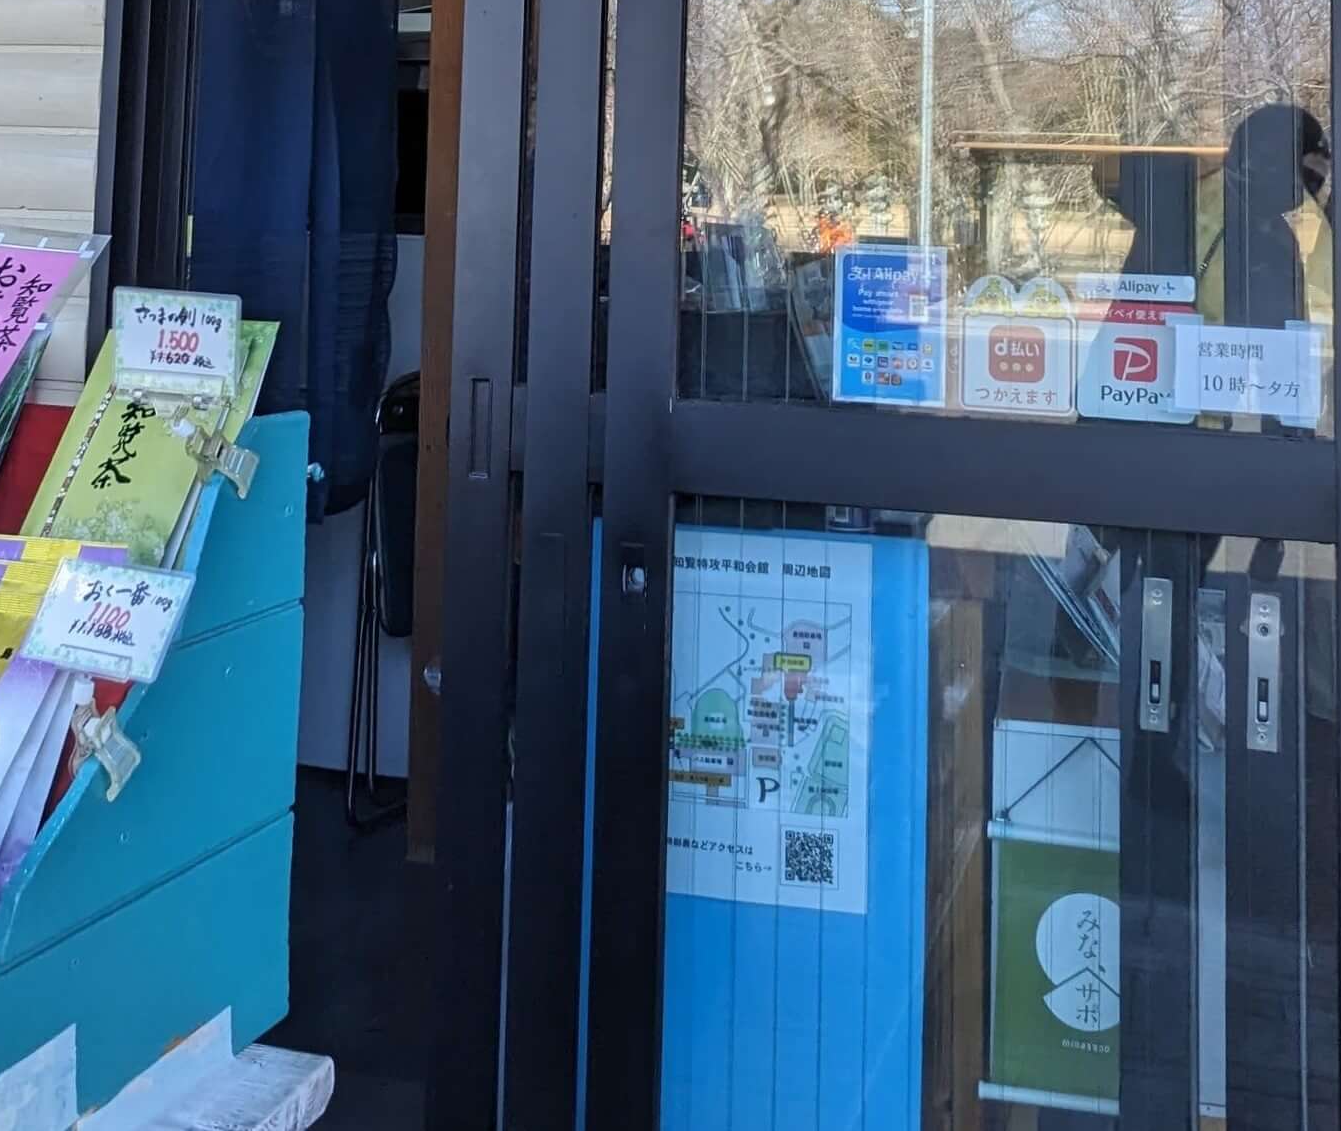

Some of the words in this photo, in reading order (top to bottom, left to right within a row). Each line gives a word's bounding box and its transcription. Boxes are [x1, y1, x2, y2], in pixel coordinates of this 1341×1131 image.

[994, 337, 1040, 357] d払い
[1198, 341, 1264, 360] 営業時間
[975, 387, 1058, 405] つかえます
